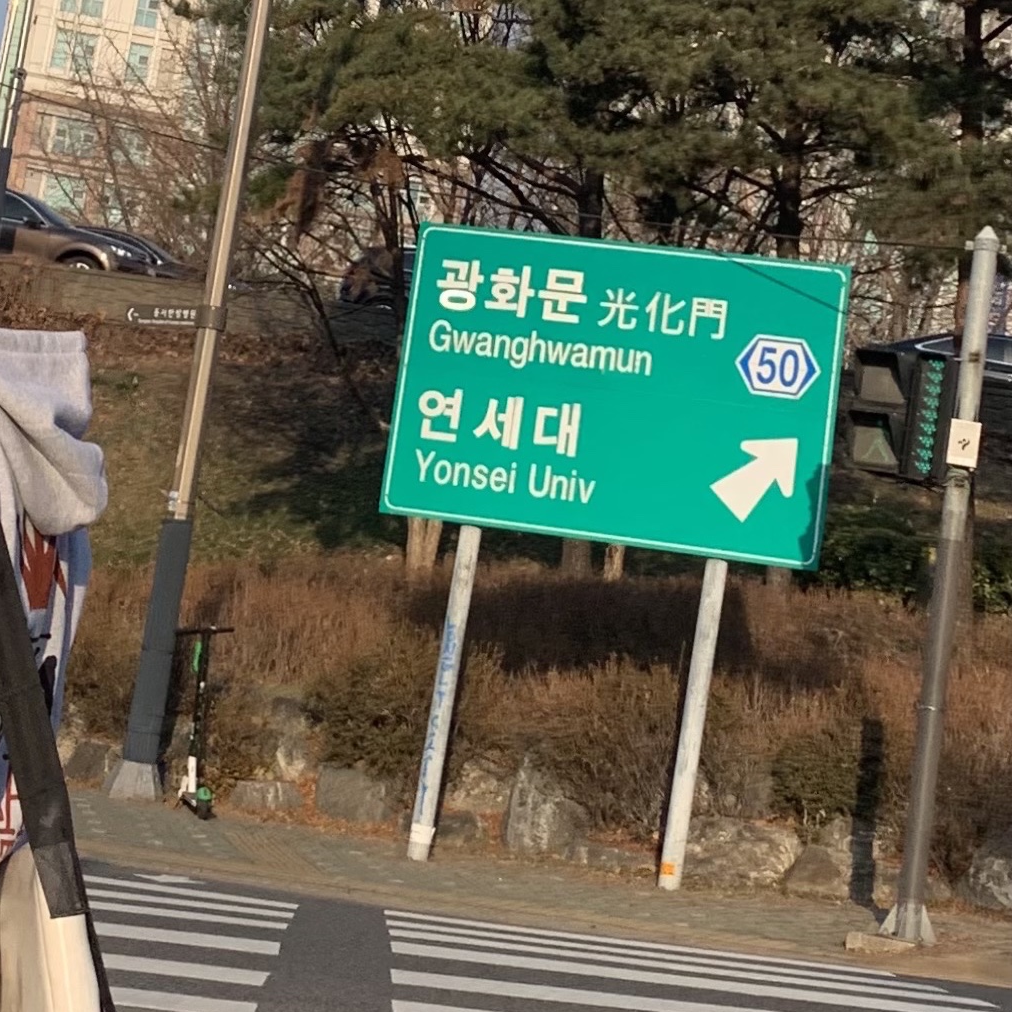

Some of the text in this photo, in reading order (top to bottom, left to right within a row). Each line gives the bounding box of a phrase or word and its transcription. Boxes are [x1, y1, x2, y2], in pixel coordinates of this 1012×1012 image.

[436, 259, 728, 340] 광화문 光化門
[428, 319, 652, 376] Gwanghwamun
[755, 346, 800, 388] 50
[415, 449, 596, 504] Yonsei Univ
